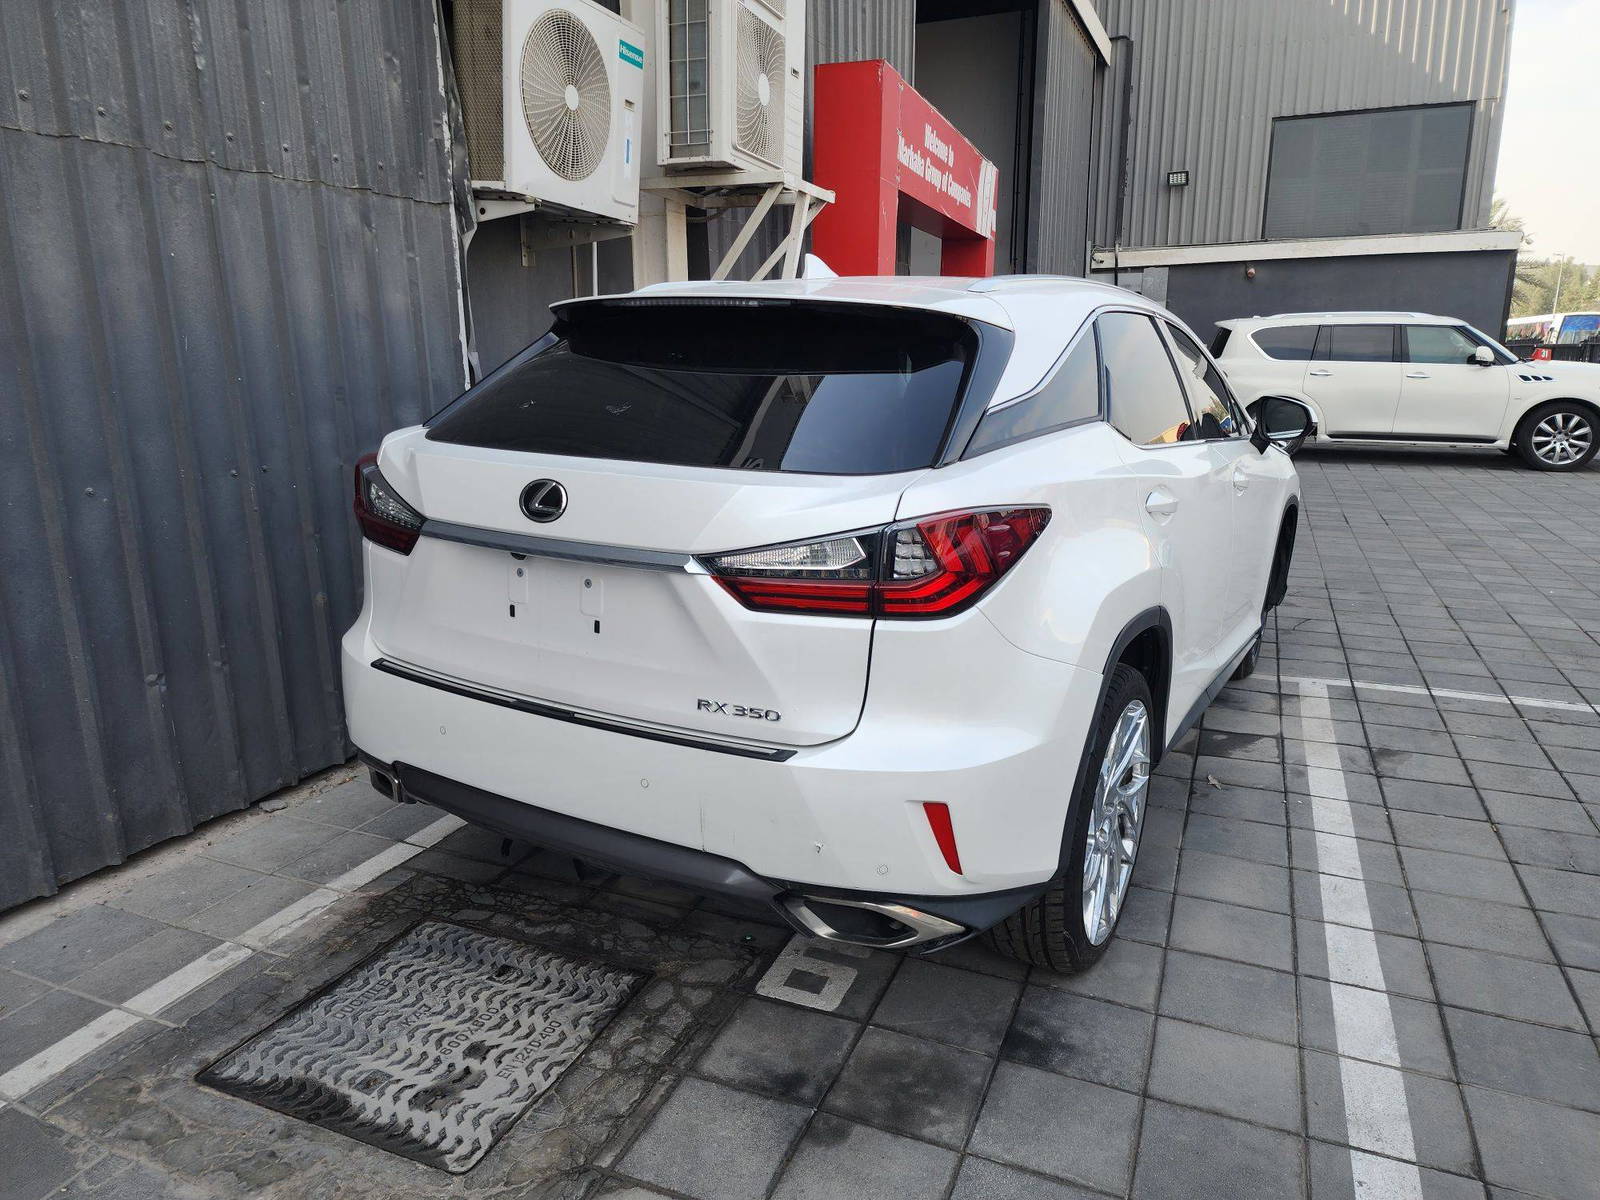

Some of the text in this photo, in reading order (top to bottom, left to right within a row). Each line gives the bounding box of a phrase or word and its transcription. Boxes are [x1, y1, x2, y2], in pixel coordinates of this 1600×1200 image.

[925, 123, 954, 168] Welcome to
[925, 157, 942, 193] Group
[942, 171, 949, 193] of
[697, 698, 781, 721] RX 350
